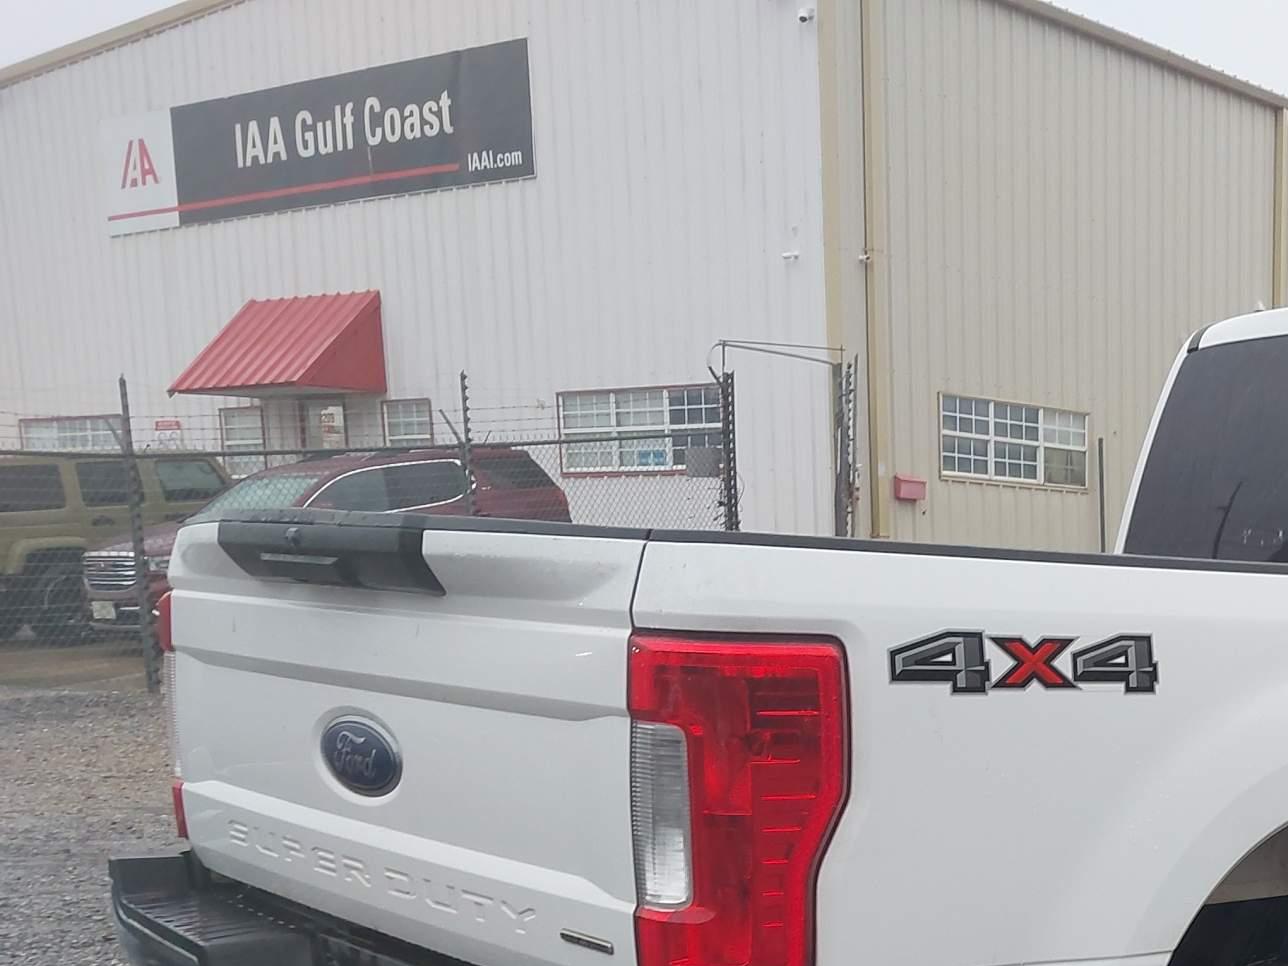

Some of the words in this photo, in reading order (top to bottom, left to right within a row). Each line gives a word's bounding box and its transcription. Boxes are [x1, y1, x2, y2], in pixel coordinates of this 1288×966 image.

[234, 116, 288, 169] IAA
[294, 103, 355, 159] Gulf
[364, 89, 455, 147] Coast
[334, 730, 378, 779] Ford
[227, 819, 373, 888] SUPER
[383, 866, 537, 935] DUTY
